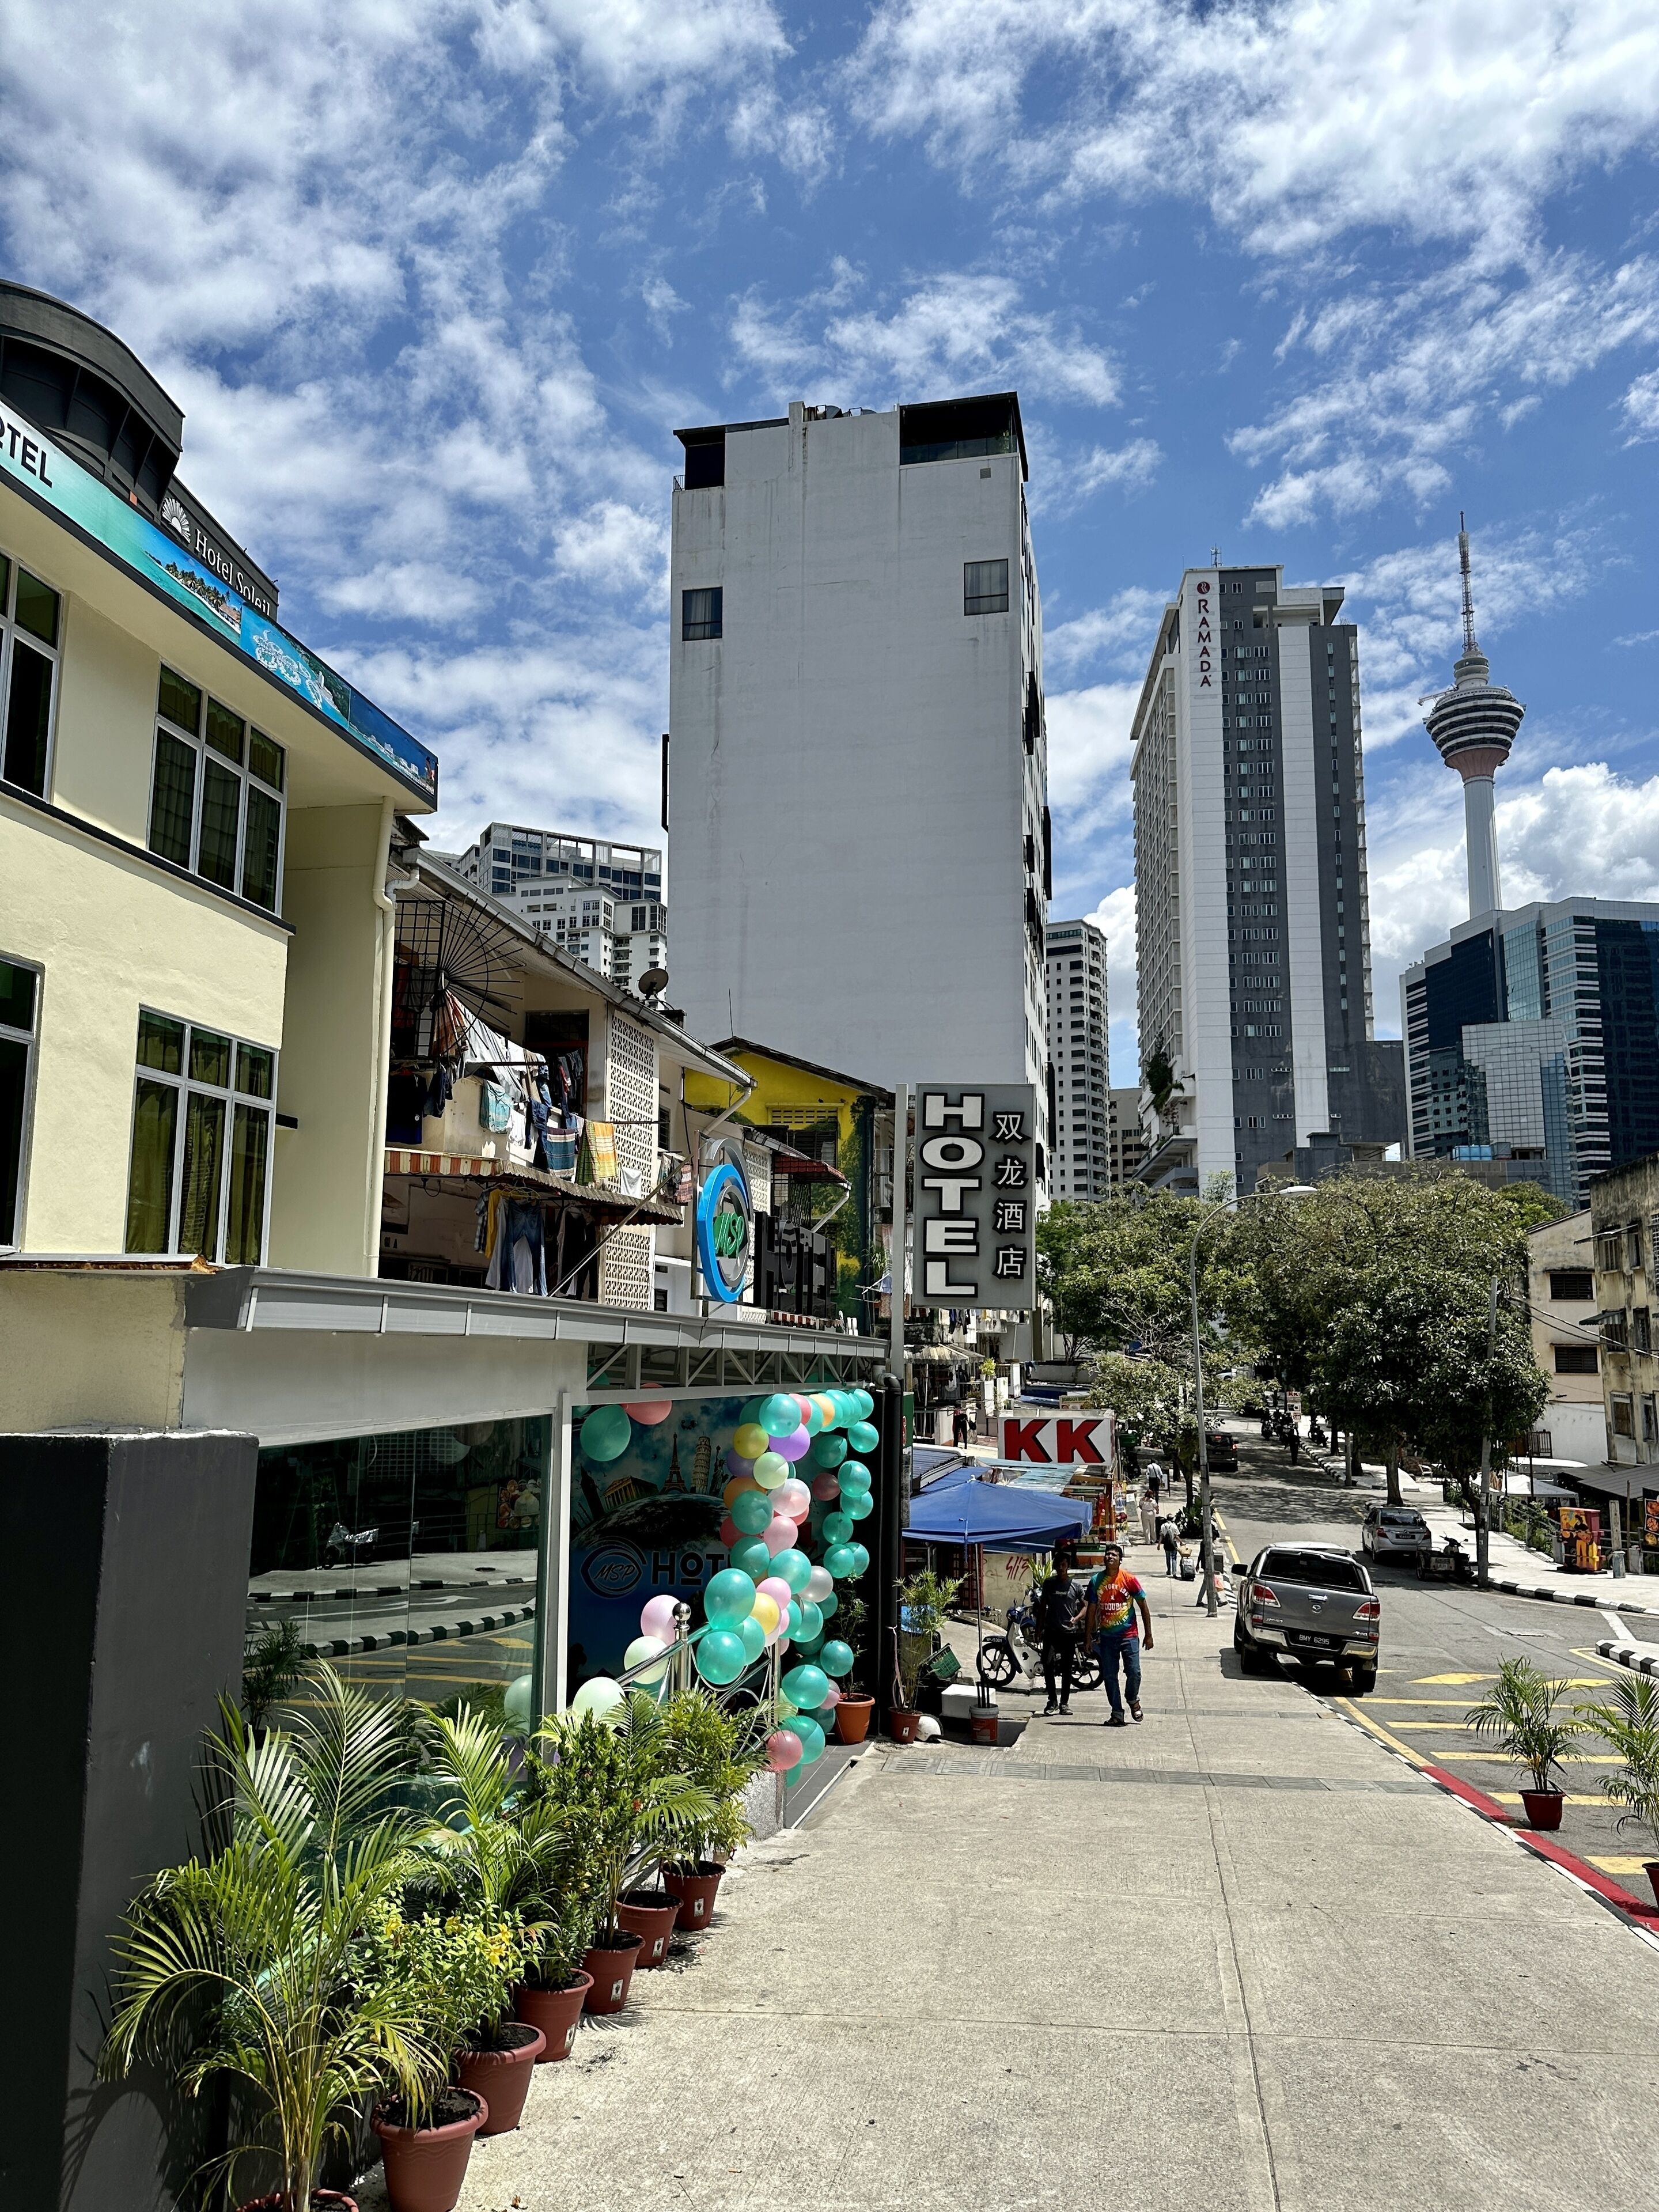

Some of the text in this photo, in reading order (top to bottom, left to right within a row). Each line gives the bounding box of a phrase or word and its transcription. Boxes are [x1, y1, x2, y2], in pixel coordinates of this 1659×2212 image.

[195, 528, 234, 586] Hotel
[1198, 599, 1212, 688] RAMADA
[920, 1092, 985, 1297] HOTEL
[992, 1112, 1028, 1278] 双龙酒店
[713, 1211, 745, 1259] MSP
[1004, 1419, 1105, 1463] KK
[593, 1551, 730, 1586] MSP HOT
[1299, 1634, 1330, 1645] BMY 6295
